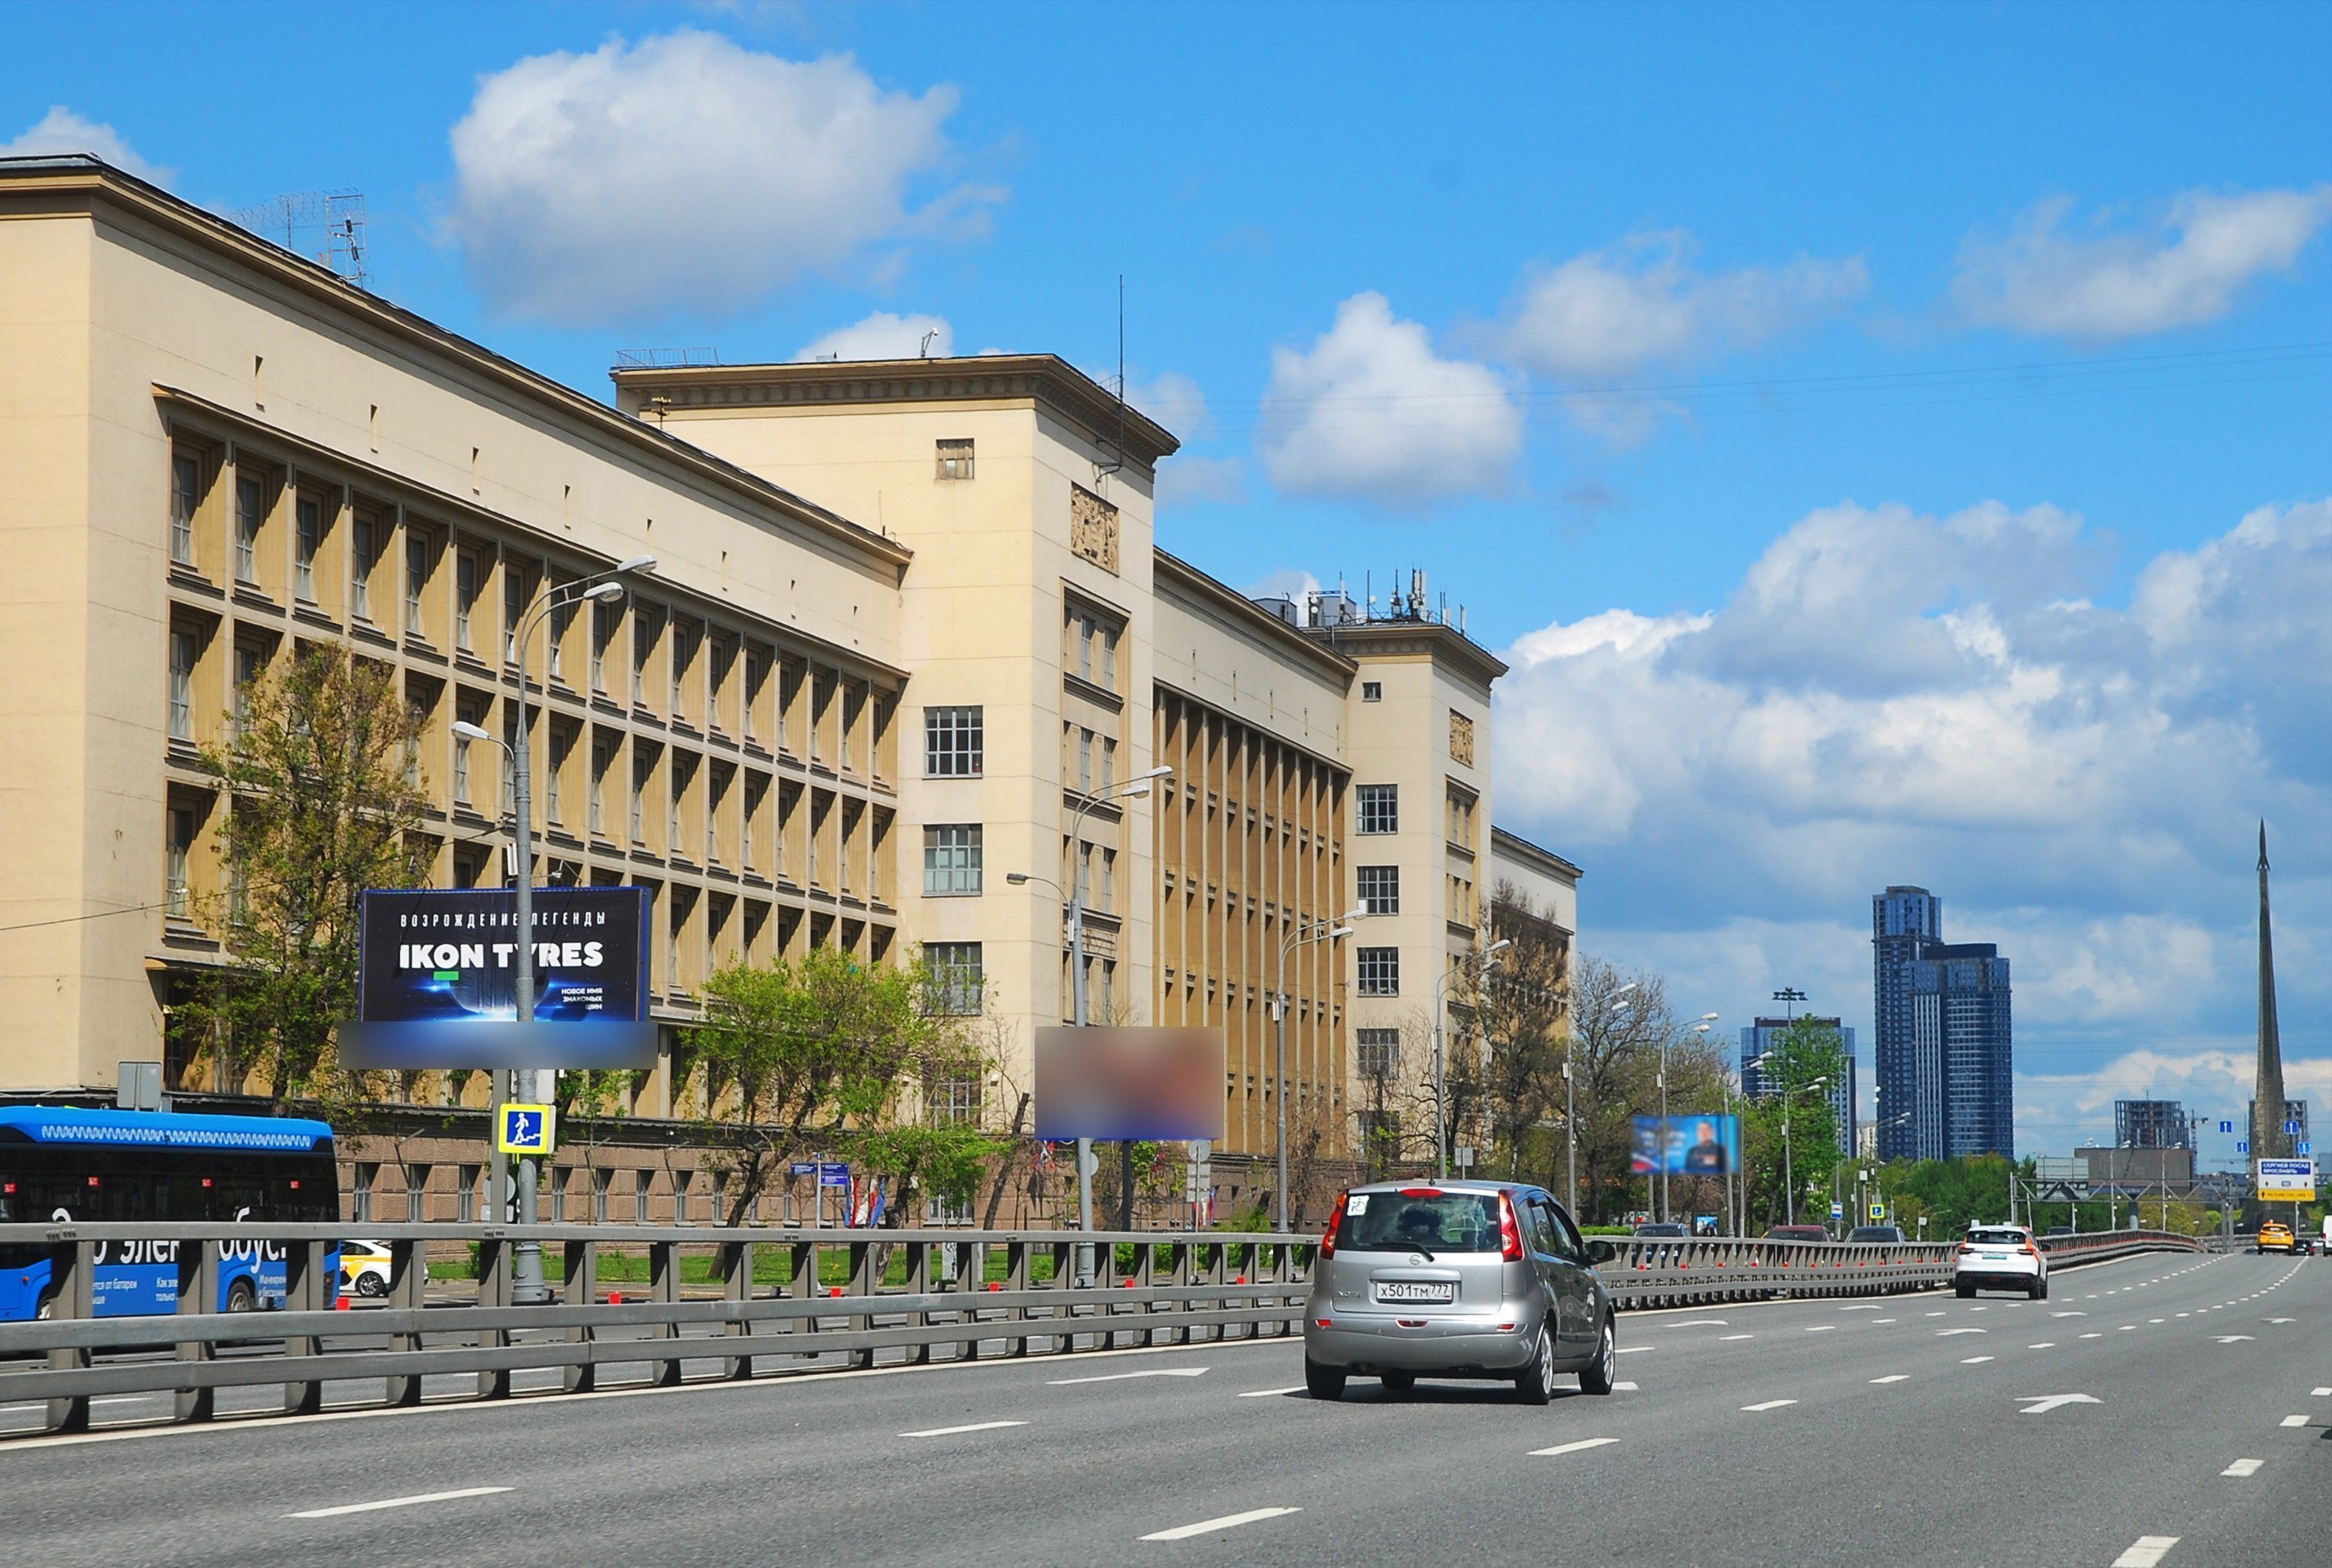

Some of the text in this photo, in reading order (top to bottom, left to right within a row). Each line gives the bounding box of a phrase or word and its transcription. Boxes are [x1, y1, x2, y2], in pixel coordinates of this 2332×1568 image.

[400, 911, 605, 929] ВОЗРОЖДЕНИЕ ЛЕГЕНДЫ
[399, 943, 484, 969] IKON
[1430, 1283, 1449, 1295] 777
